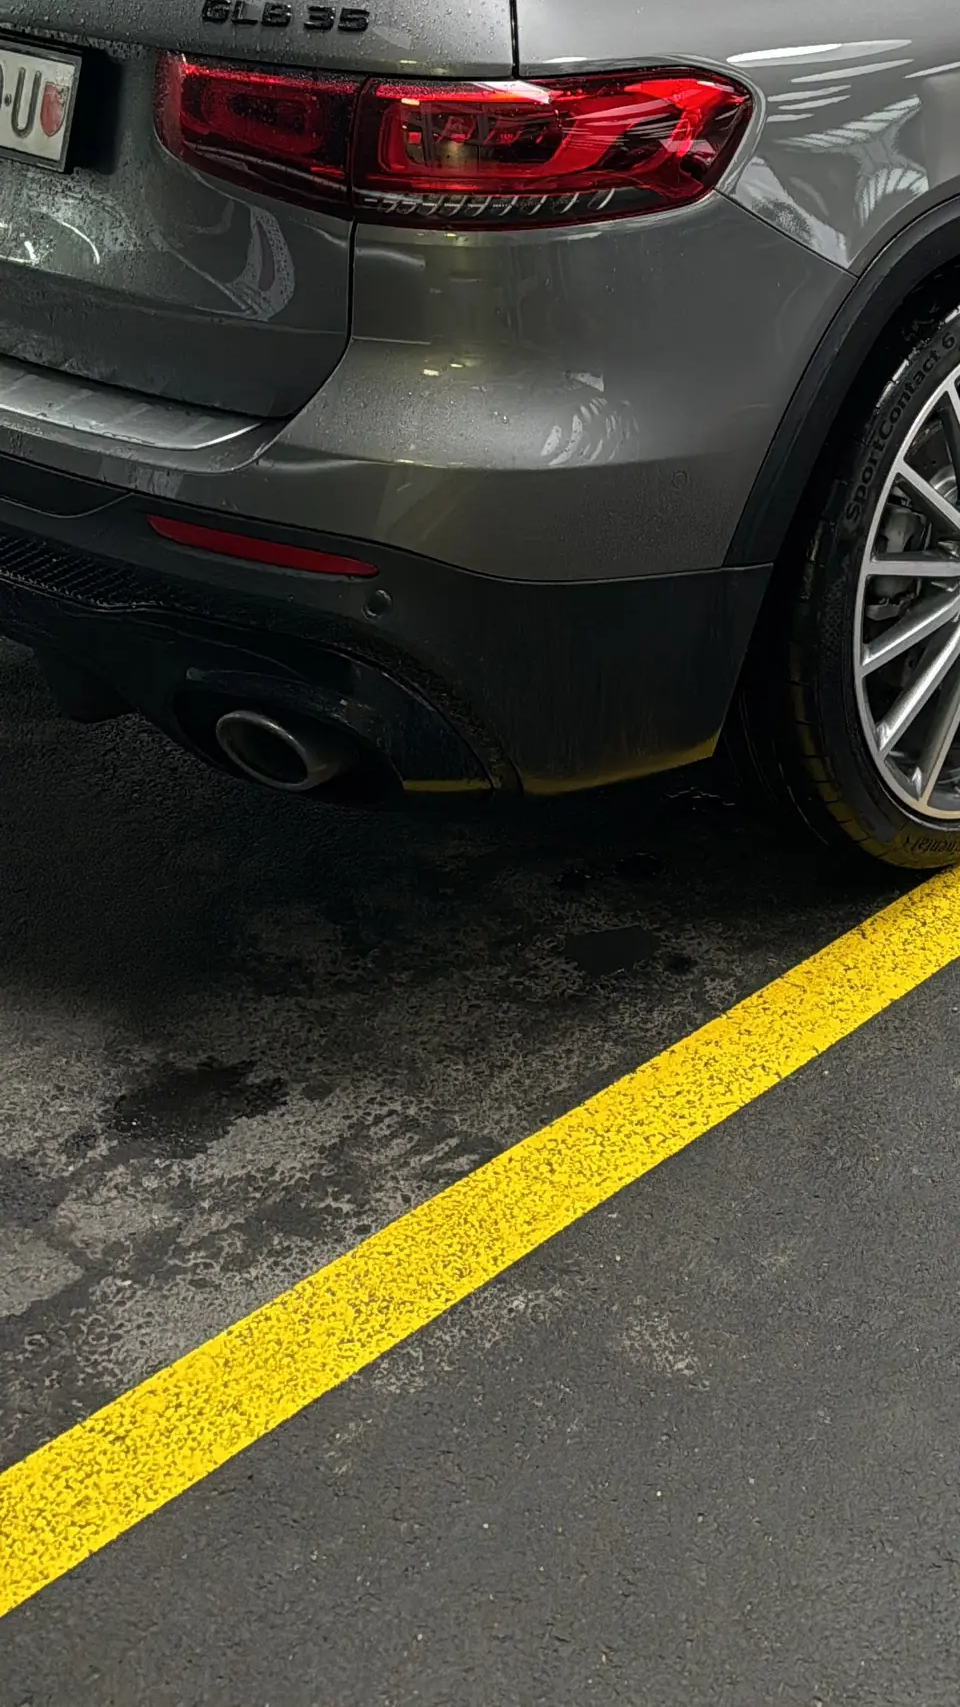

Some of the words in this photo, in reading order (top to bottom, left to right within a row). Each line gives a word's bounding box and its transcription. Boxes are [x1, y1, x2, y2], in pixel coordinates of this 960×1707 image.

[304, 4, 370, 31] 35
[845, 349, 941, 522] SportContact
[941, 332, 956, 350] 6
